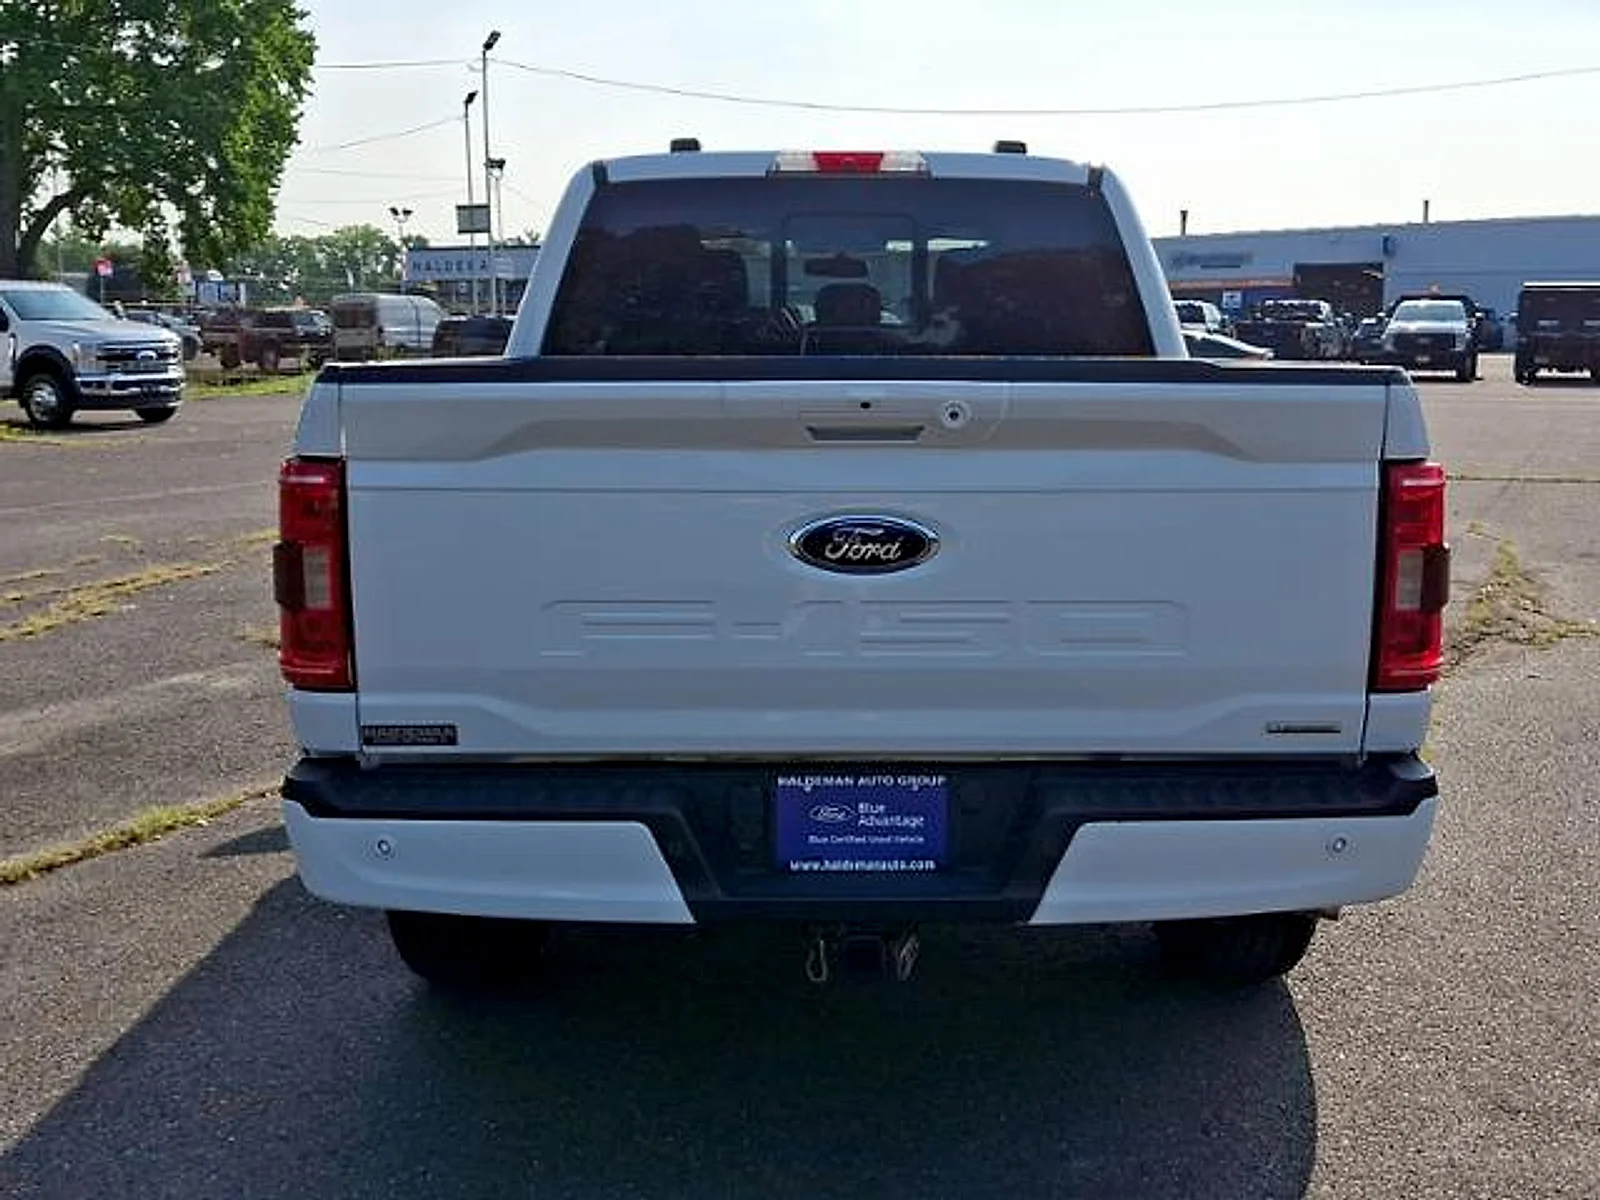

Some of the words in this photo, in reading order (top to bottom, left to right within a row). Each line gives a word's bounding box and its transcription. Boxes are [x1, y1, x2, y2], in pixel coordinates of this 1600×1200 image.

[823, 527, 904, 561] Ford
[540, 600, 1190, 656] F-150
[777, 775, 854, 787] HALDEMAN
[857, 775, 893, 786] AUTO
[897, 775, 947, 787] GROUP
[858, 802, 886, 814] Blue
[858, 815, 925, 829] Advantage
